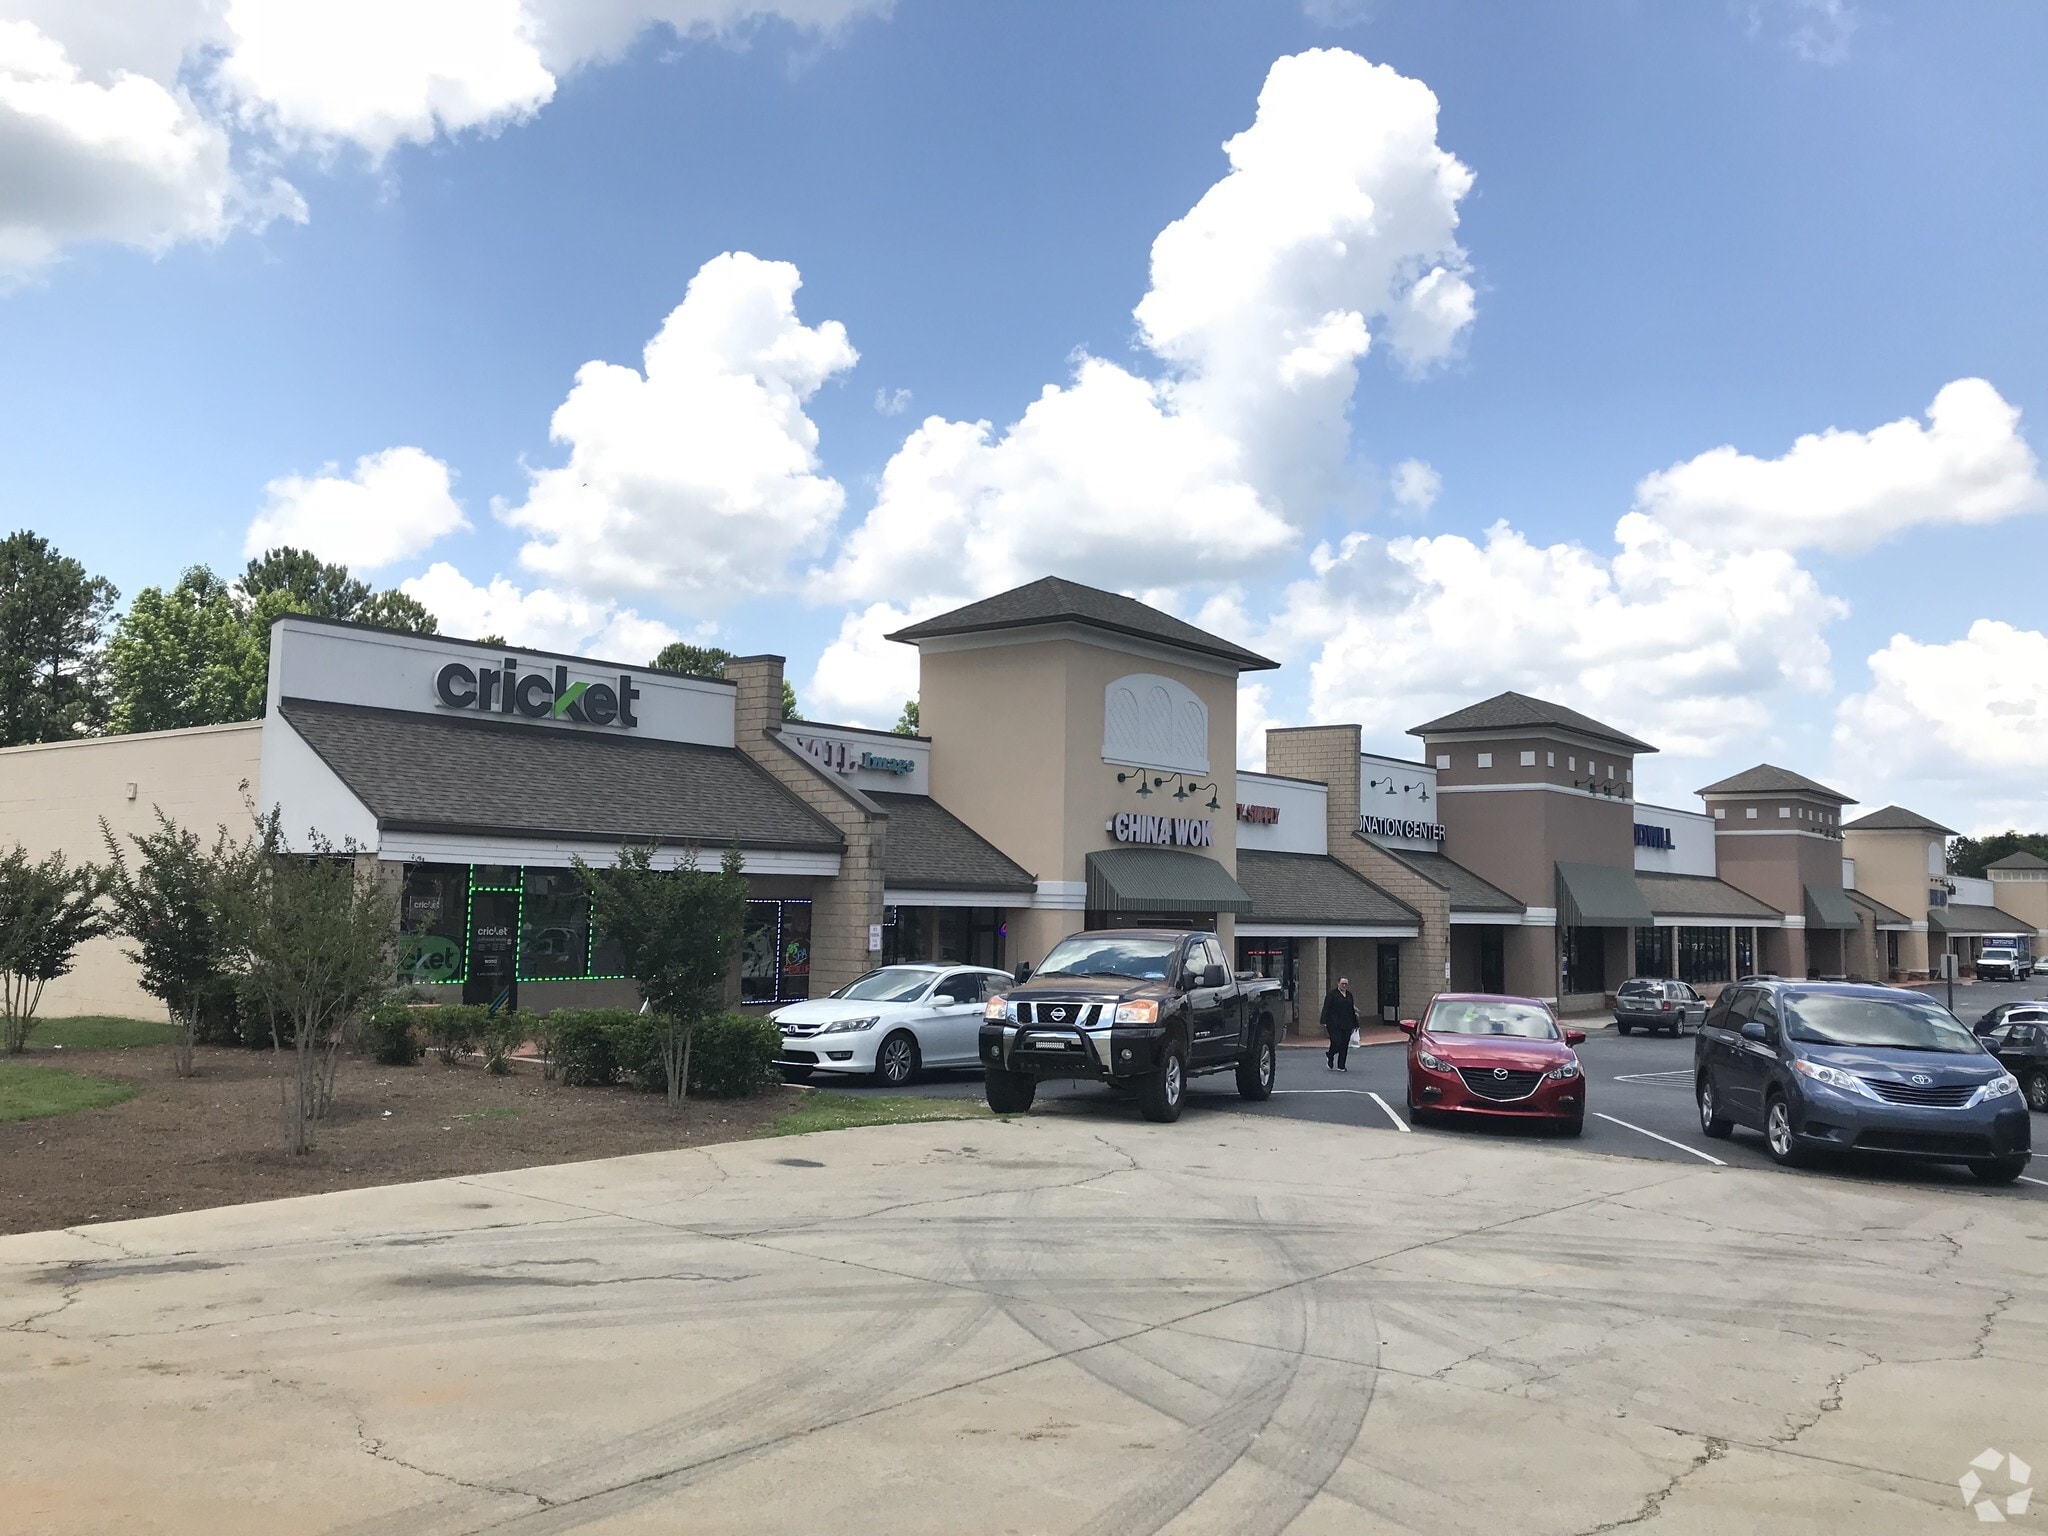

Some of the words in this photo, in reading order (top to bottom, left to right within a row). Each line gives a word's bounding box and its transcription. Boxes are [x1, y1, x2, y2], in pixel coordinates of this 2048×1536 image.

[436, 657, 640, 728] cricket
[862, 751, 915, 777] Image
[1247, 804, 1281, 825] SUPPLY
[1113, 812, 1173, 846] CHINA
[1174, 818, 1214, 847] WOK
[1360, 815, 1403, 837] NATION
[1405, 821, 1446, 841] CENTER
[477, 926, 508, 936] cricket
[792, 948, 809, 964] SPA
